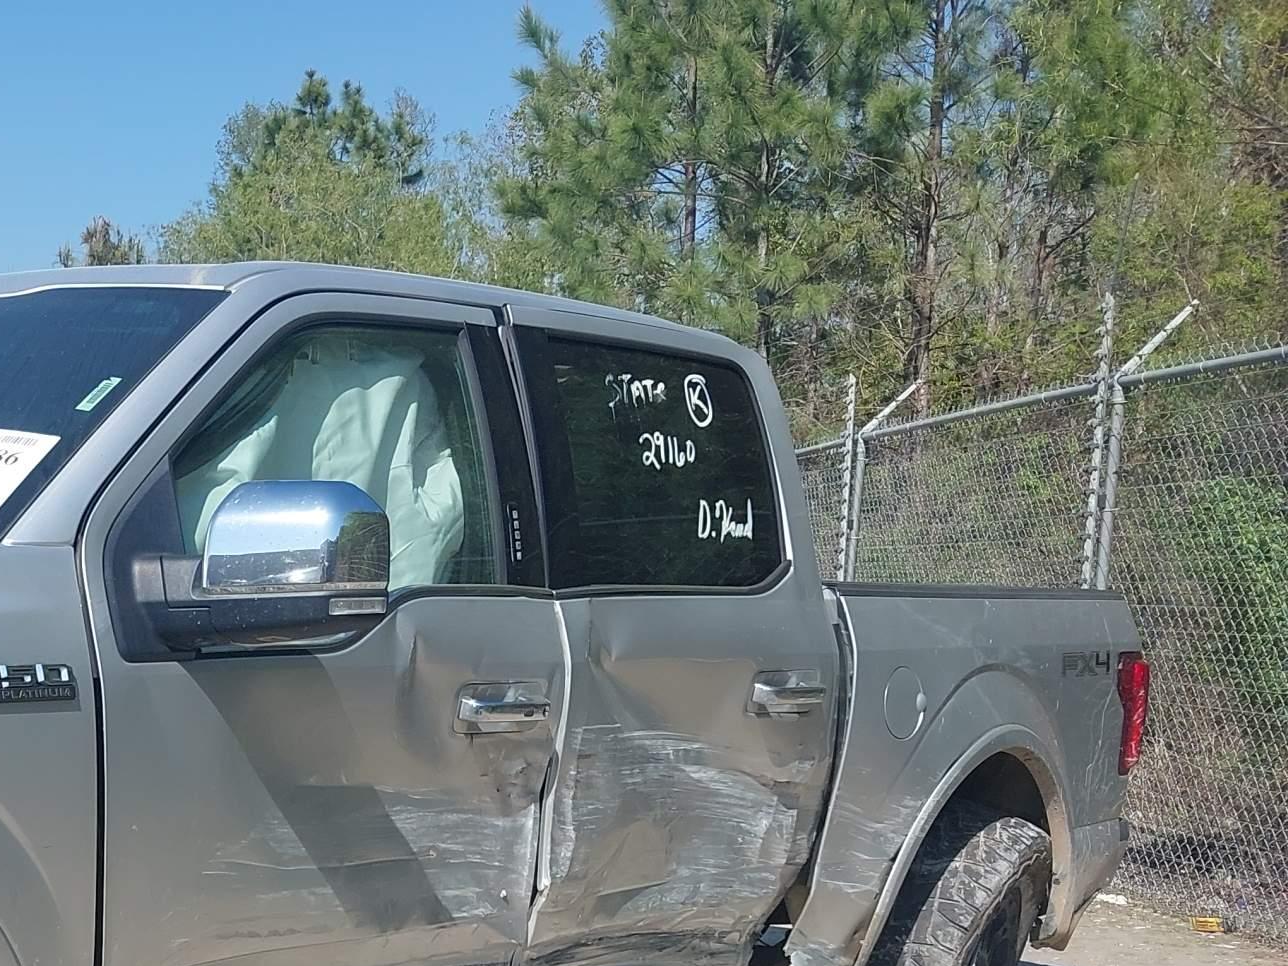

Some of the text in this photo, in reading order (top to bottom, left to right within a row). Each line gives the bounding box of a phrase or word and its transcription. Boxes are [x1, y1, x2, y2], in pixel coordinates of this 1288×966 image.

[638, 431, 696, 471] 29160
[1063, 651, 1111, 677] FX4
[0, 686, 73, 699] PLATINUM
